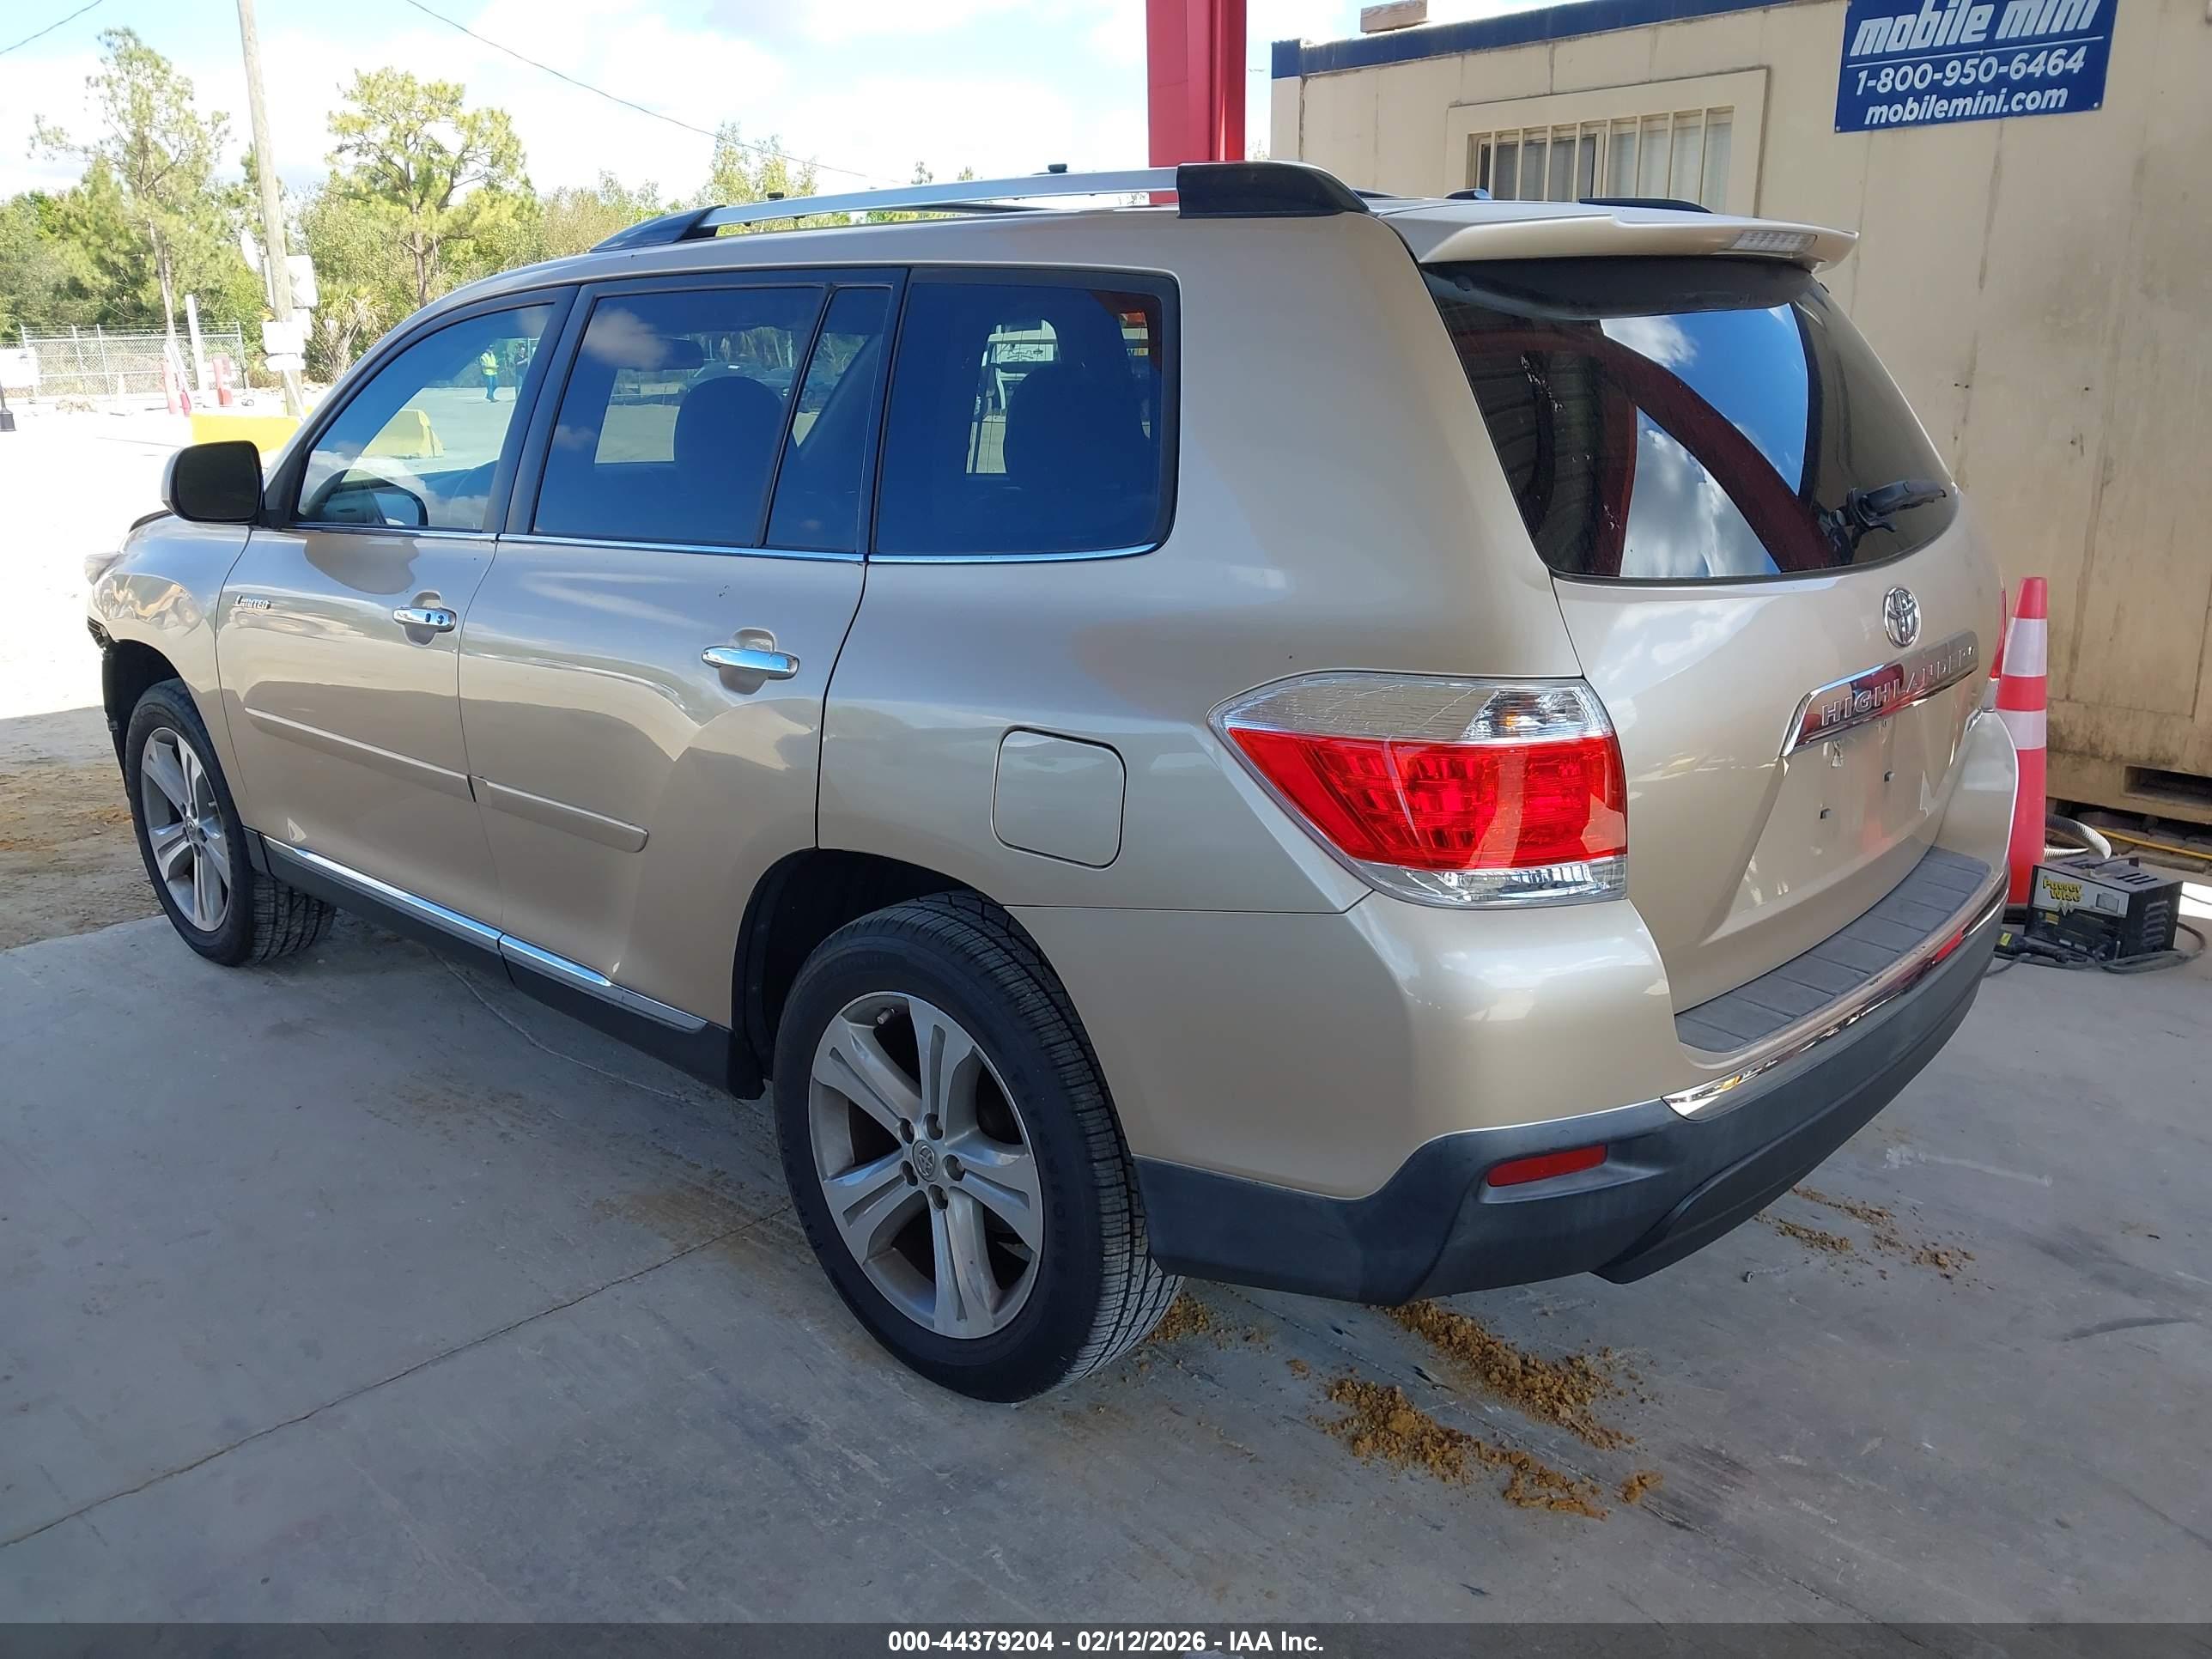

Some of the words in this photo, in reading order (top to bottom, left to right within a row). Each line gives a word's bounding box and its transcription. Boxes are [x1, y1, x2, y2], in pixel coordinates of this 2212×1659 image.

[1850, 0, 1995, 57] mobile
[1995, 0, 2100, 40] mini
[1856, 46, 2087, 96] 1-800-950-6464
[1864, 88, 2069, 125] mobilemini.com
